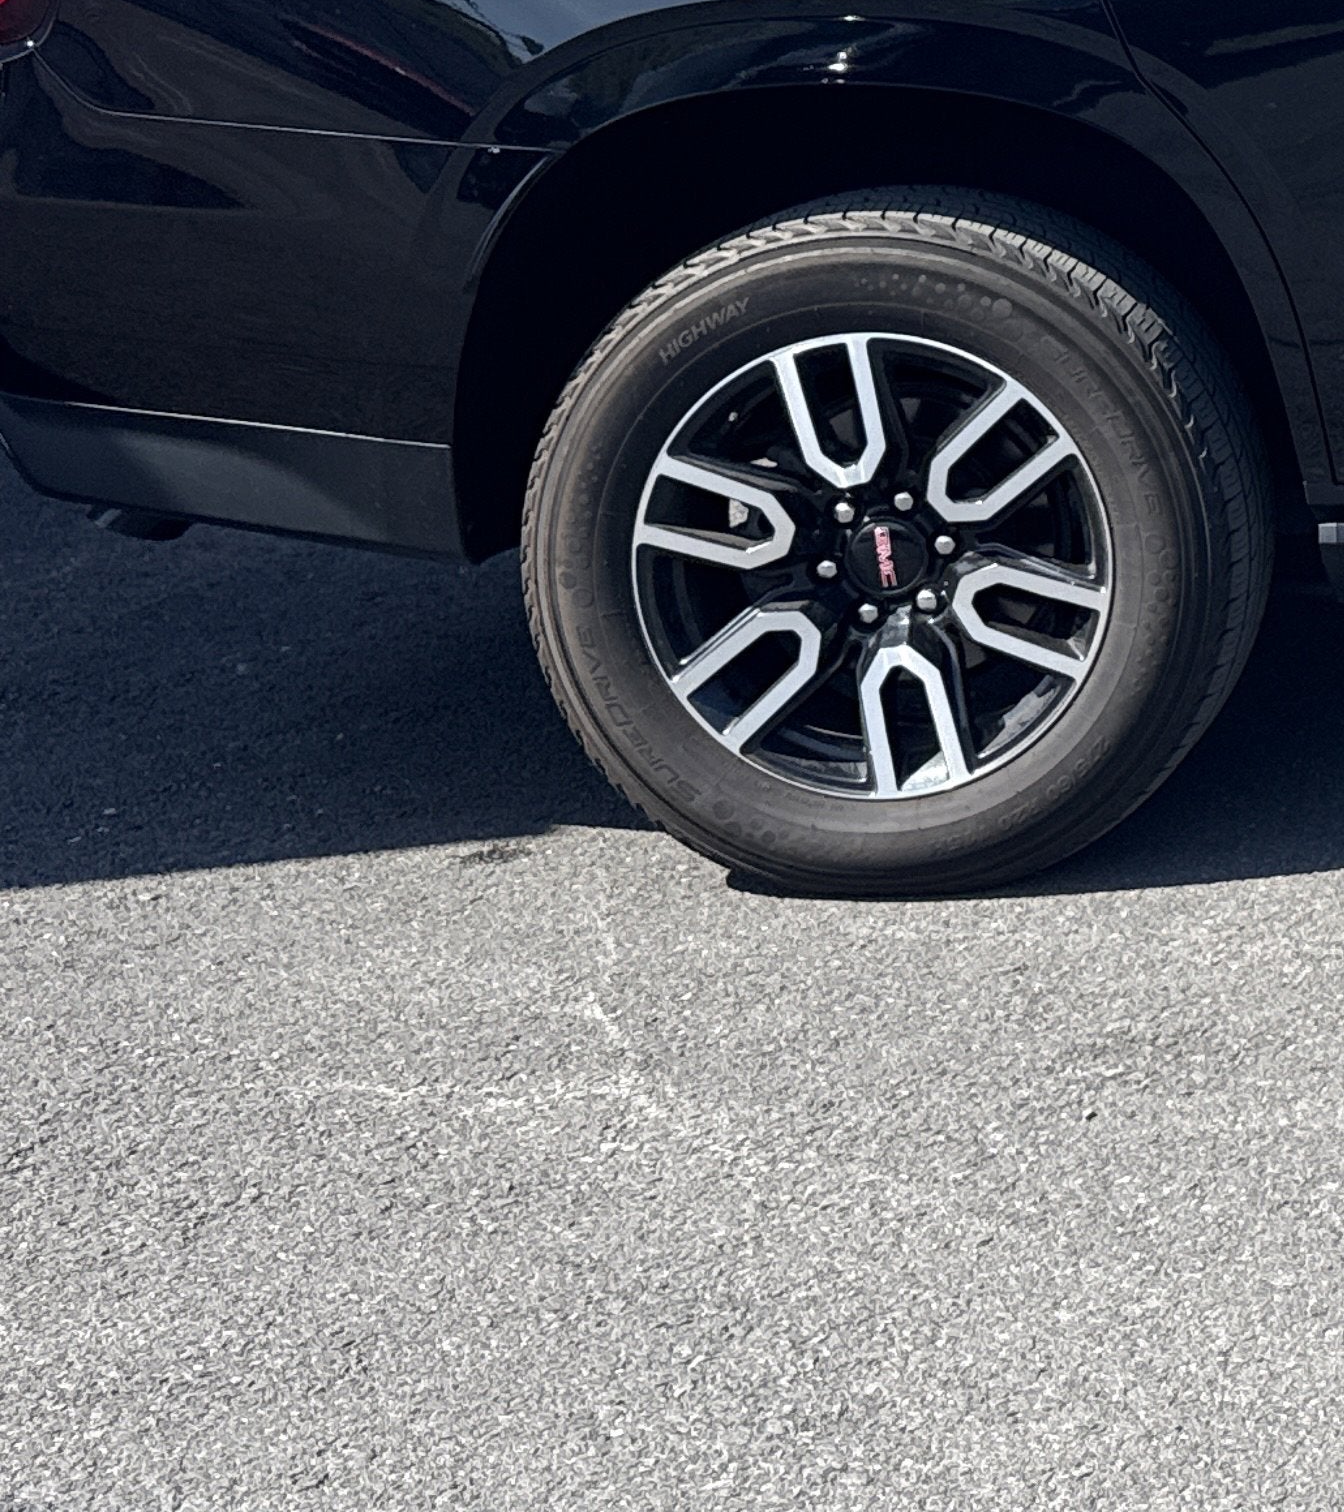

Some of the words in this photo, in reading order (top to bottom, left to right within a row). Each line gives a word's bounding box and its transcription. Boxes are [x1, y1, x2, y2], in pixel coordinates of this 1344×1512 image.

[654, 293, 755, 367] HIGHWAY
[874, 526, 898, 587] GMC
[574, 621, 702, 806] SUREDRIVE
